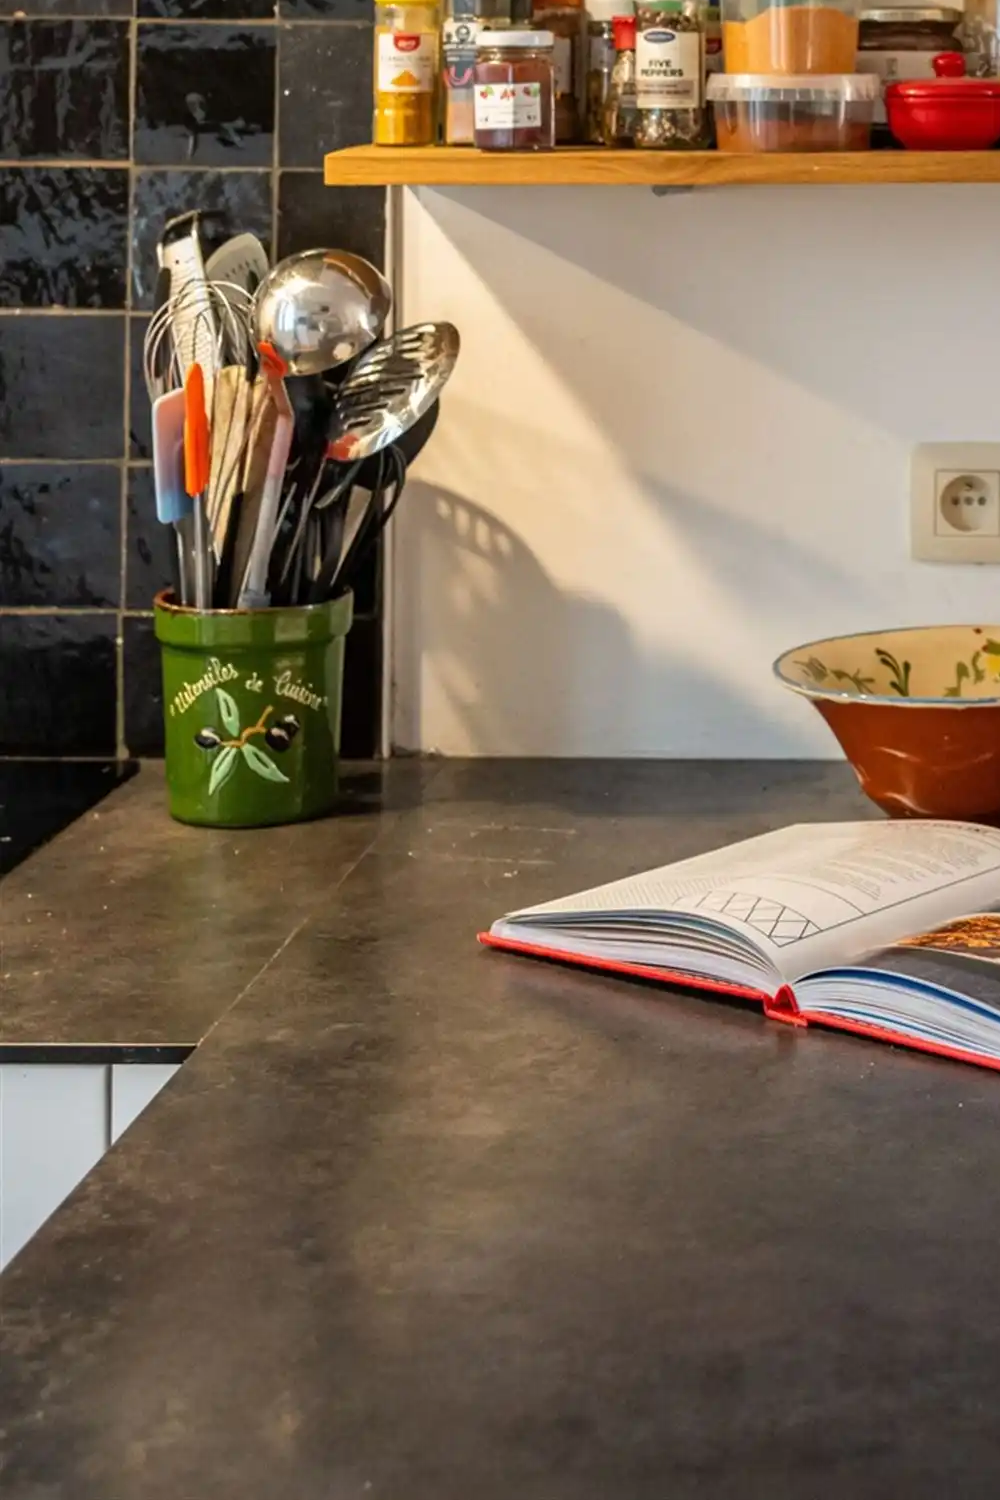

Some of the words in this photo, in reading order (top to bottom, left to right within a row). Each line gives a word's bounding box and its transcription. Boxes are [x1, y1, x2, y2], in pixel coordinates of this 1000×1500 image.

[648, 60, 672, 68] FIVE
[641, 68, 684, 77] PEPPERS
[245, 671, 264, 693] de
